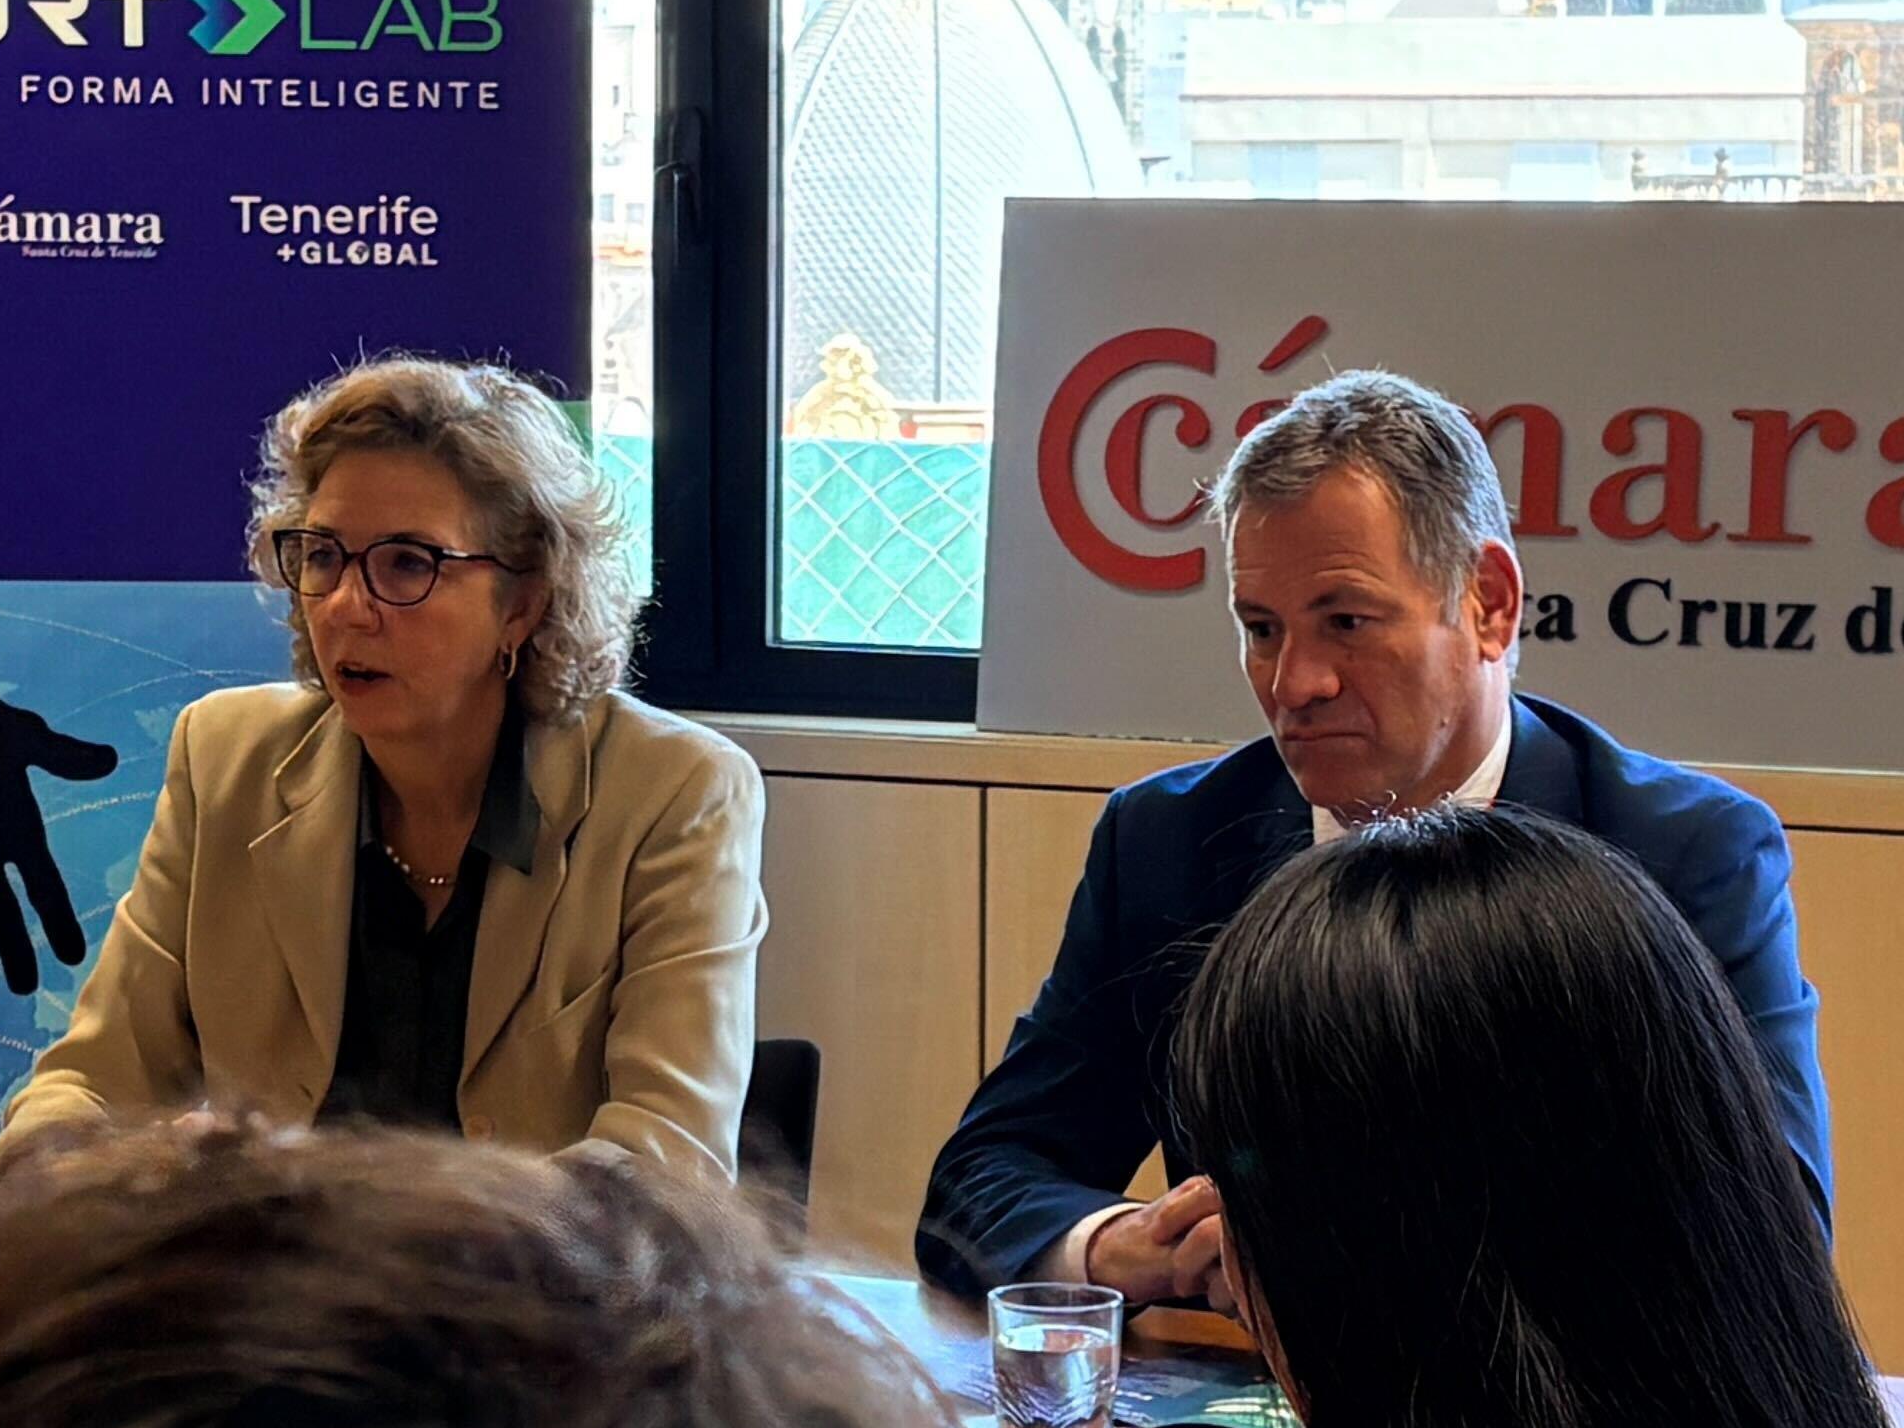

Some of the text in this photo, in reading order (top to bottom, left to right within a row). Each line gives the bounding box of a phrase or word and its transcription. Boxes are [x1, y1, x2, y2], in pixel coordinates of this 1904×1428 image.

[20, 75, 175, 105] FORMA
[201, 77, 500, 110] INTELIGENTE
[229, 194, 439, 236] Tenerife
[1607, 578, 1817, 651] Cruz
